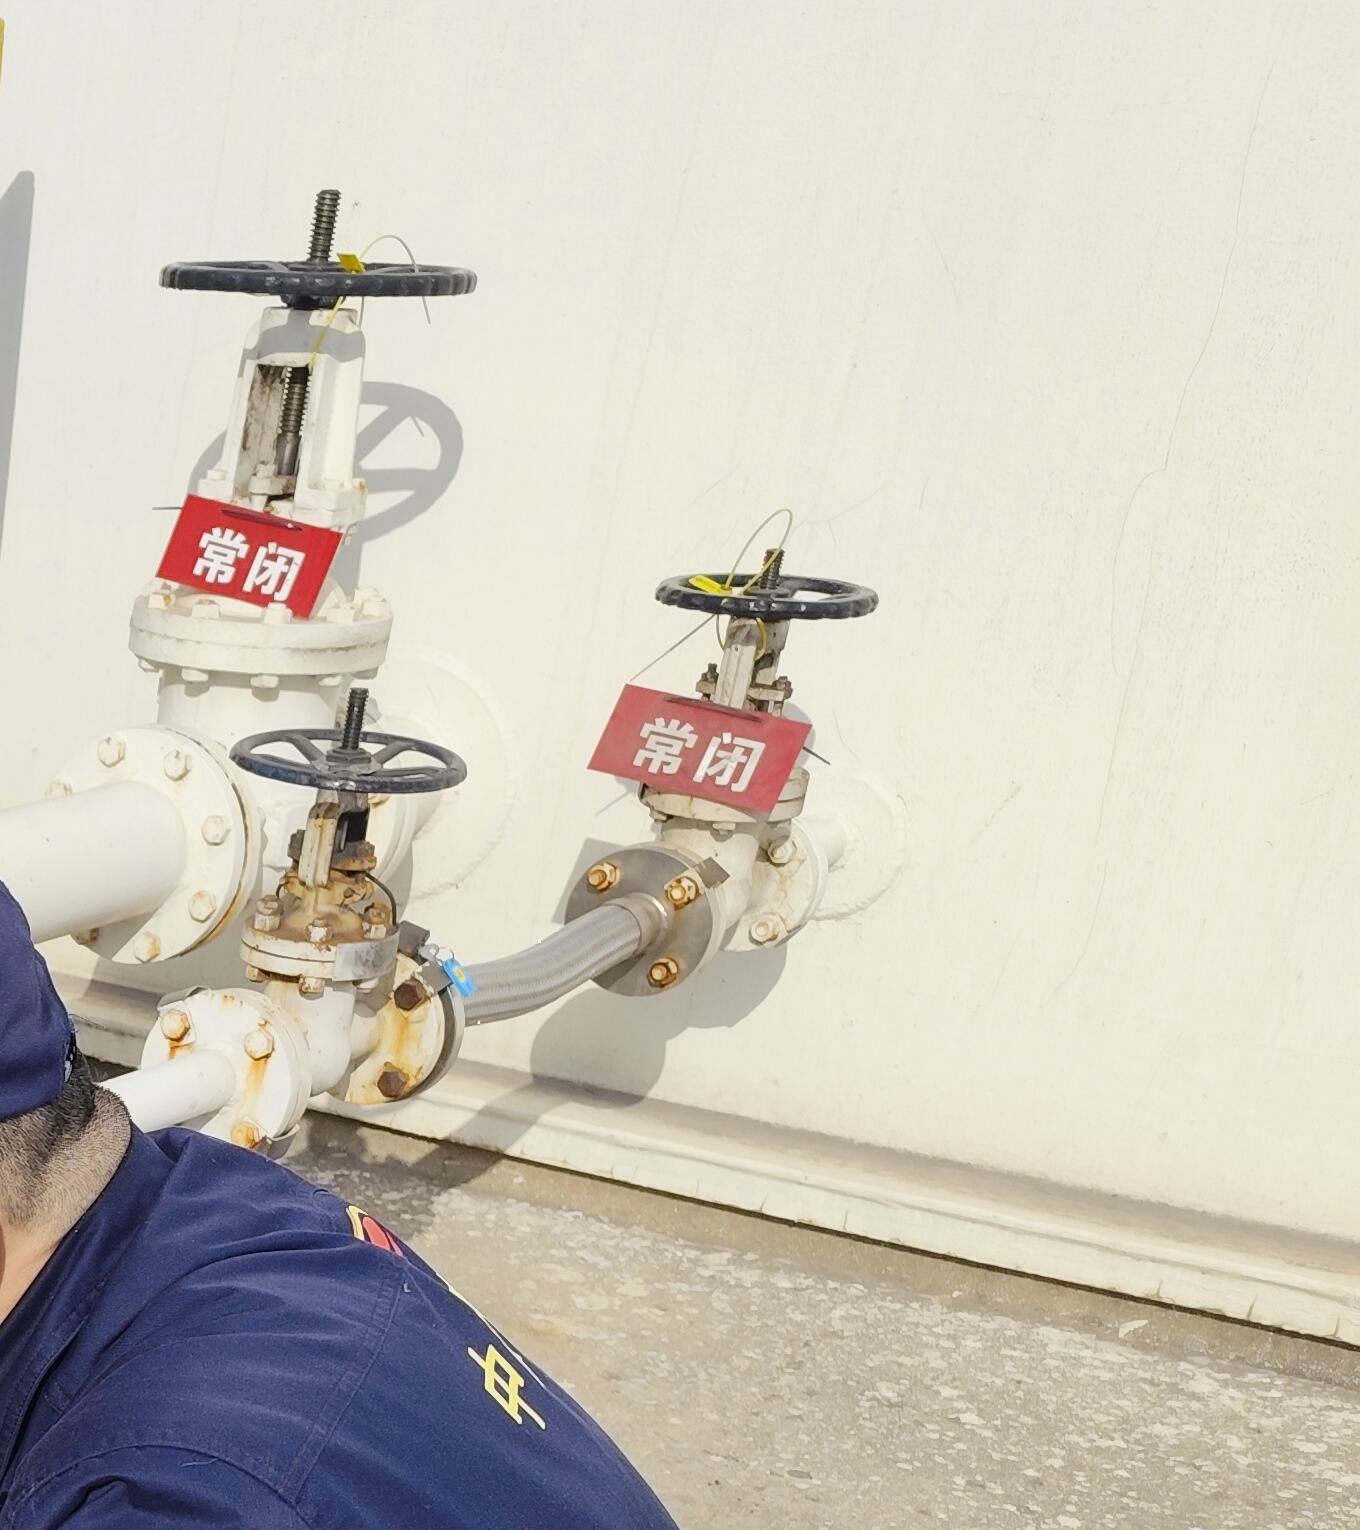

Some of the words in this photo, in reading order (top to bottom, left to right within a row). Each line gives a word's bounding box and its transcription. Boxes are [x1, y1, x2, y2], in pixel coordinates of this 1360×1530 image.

[193, 526, 306, 602] 常闭
[631, 715, 766, 793] 常闭
[468, 1344, 546, 1429] 中
